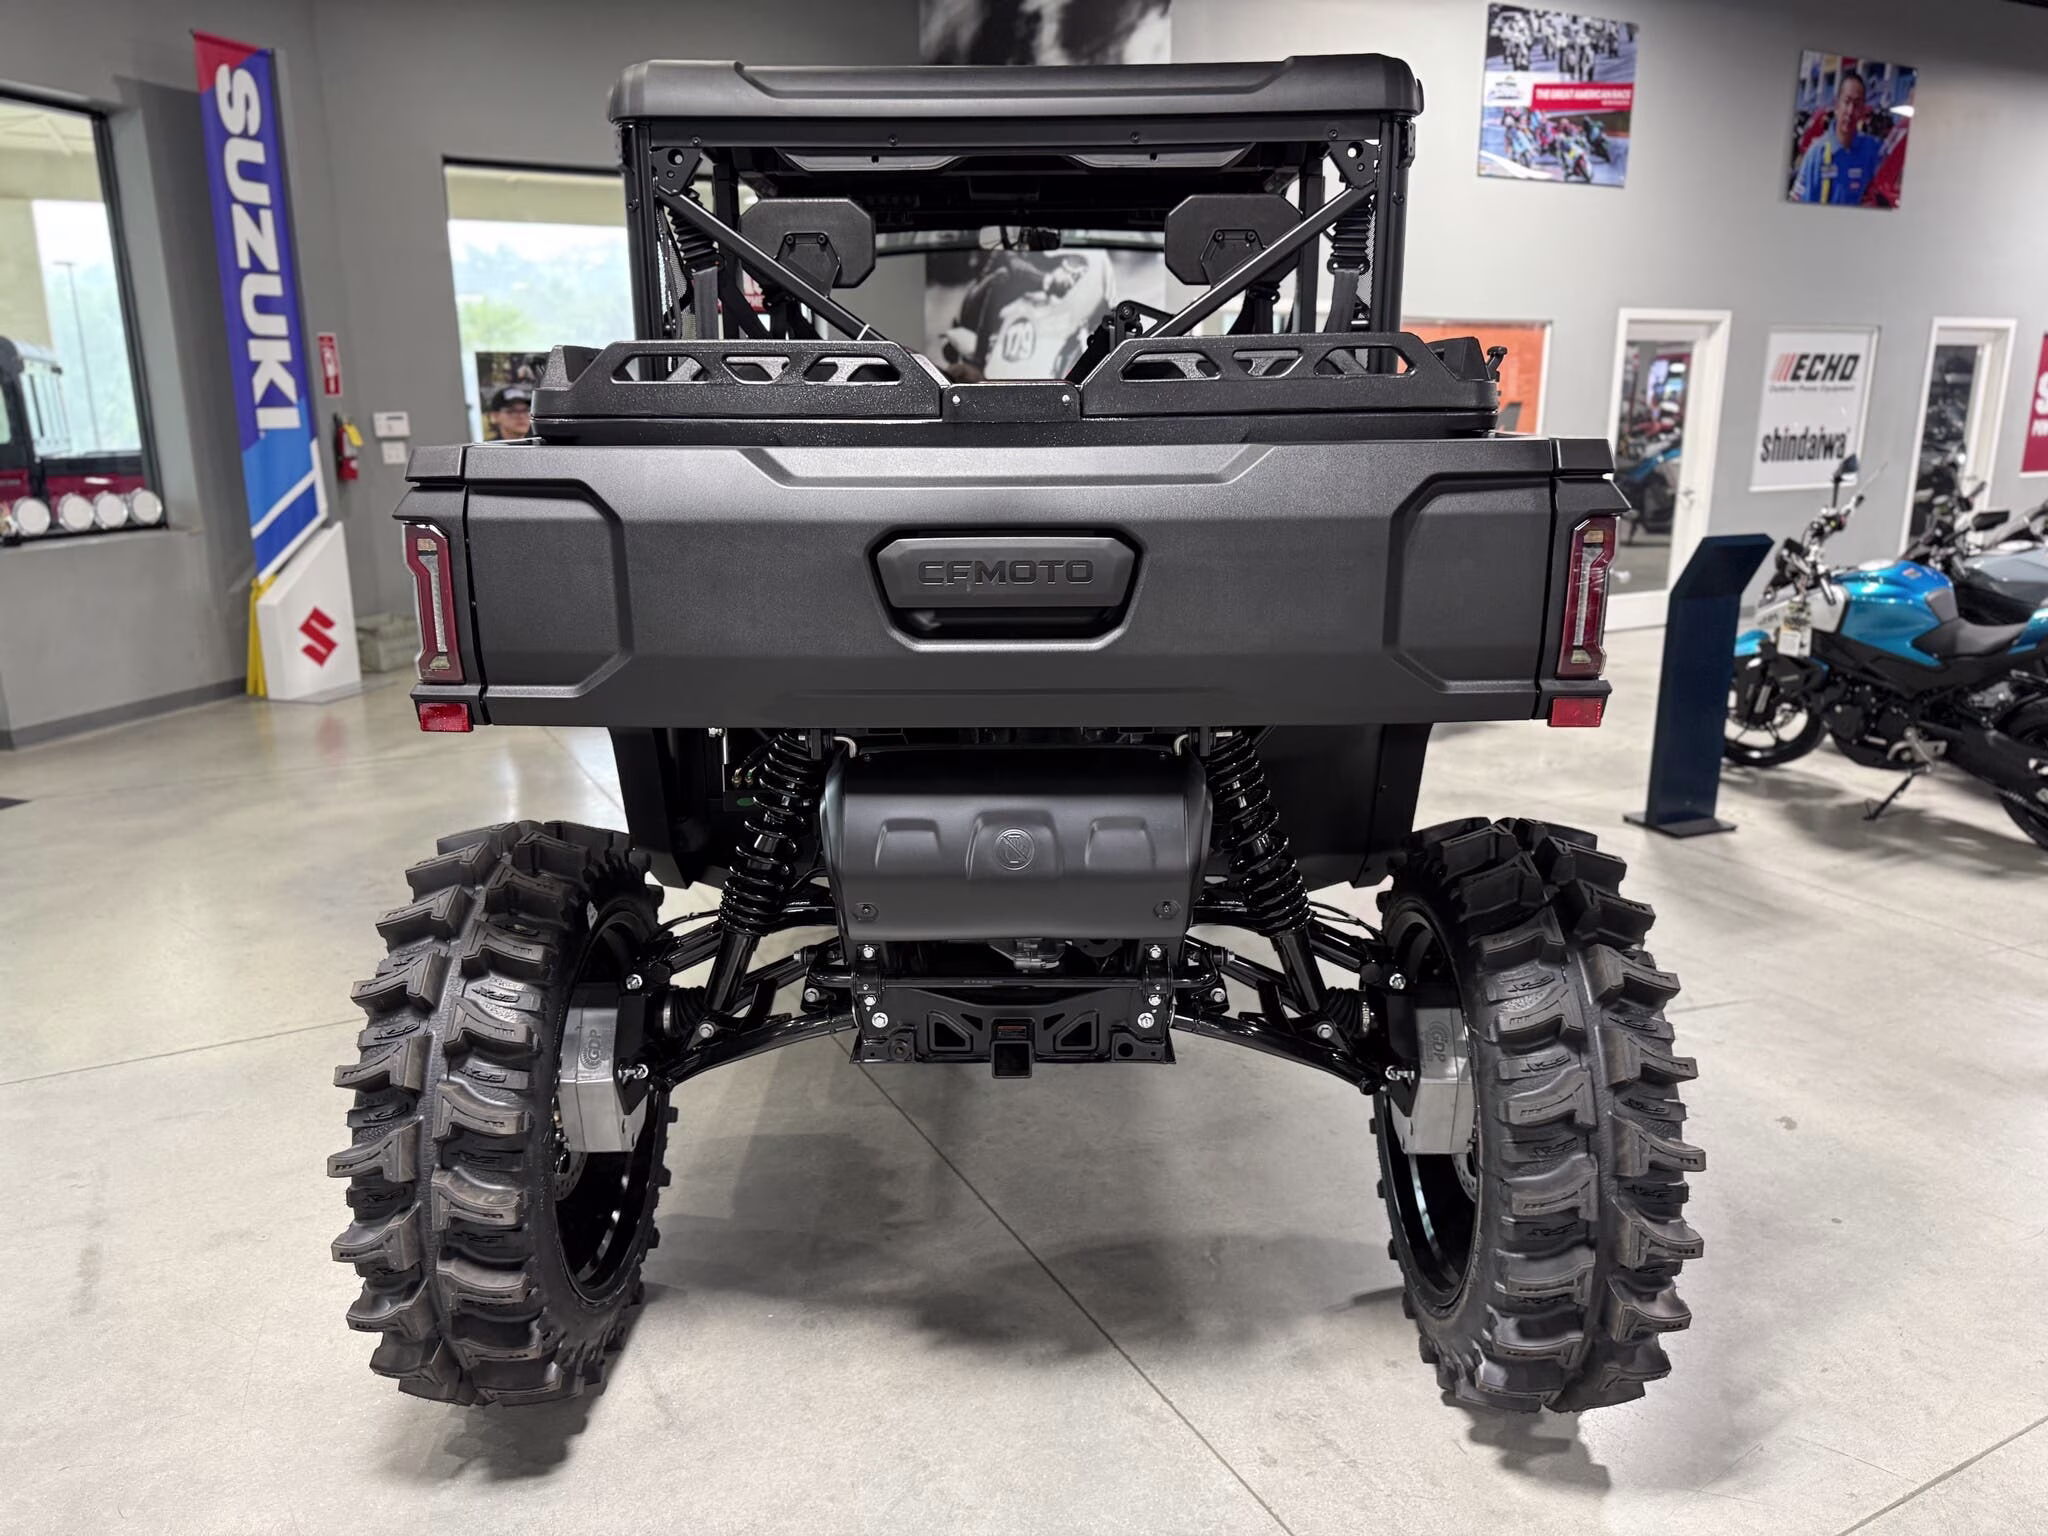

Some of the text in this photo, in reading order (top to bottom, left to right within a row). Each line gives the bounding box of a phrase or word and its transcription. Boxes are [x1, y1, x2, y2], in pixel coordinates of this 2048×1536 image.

[215, 64, 301, 429] SUZUKI
[1790, 353, 1860, 382] ECHO
[1760, 426, 1847, 463] shindaiwa
[918, 560, 1094, 585] CFMOTO
